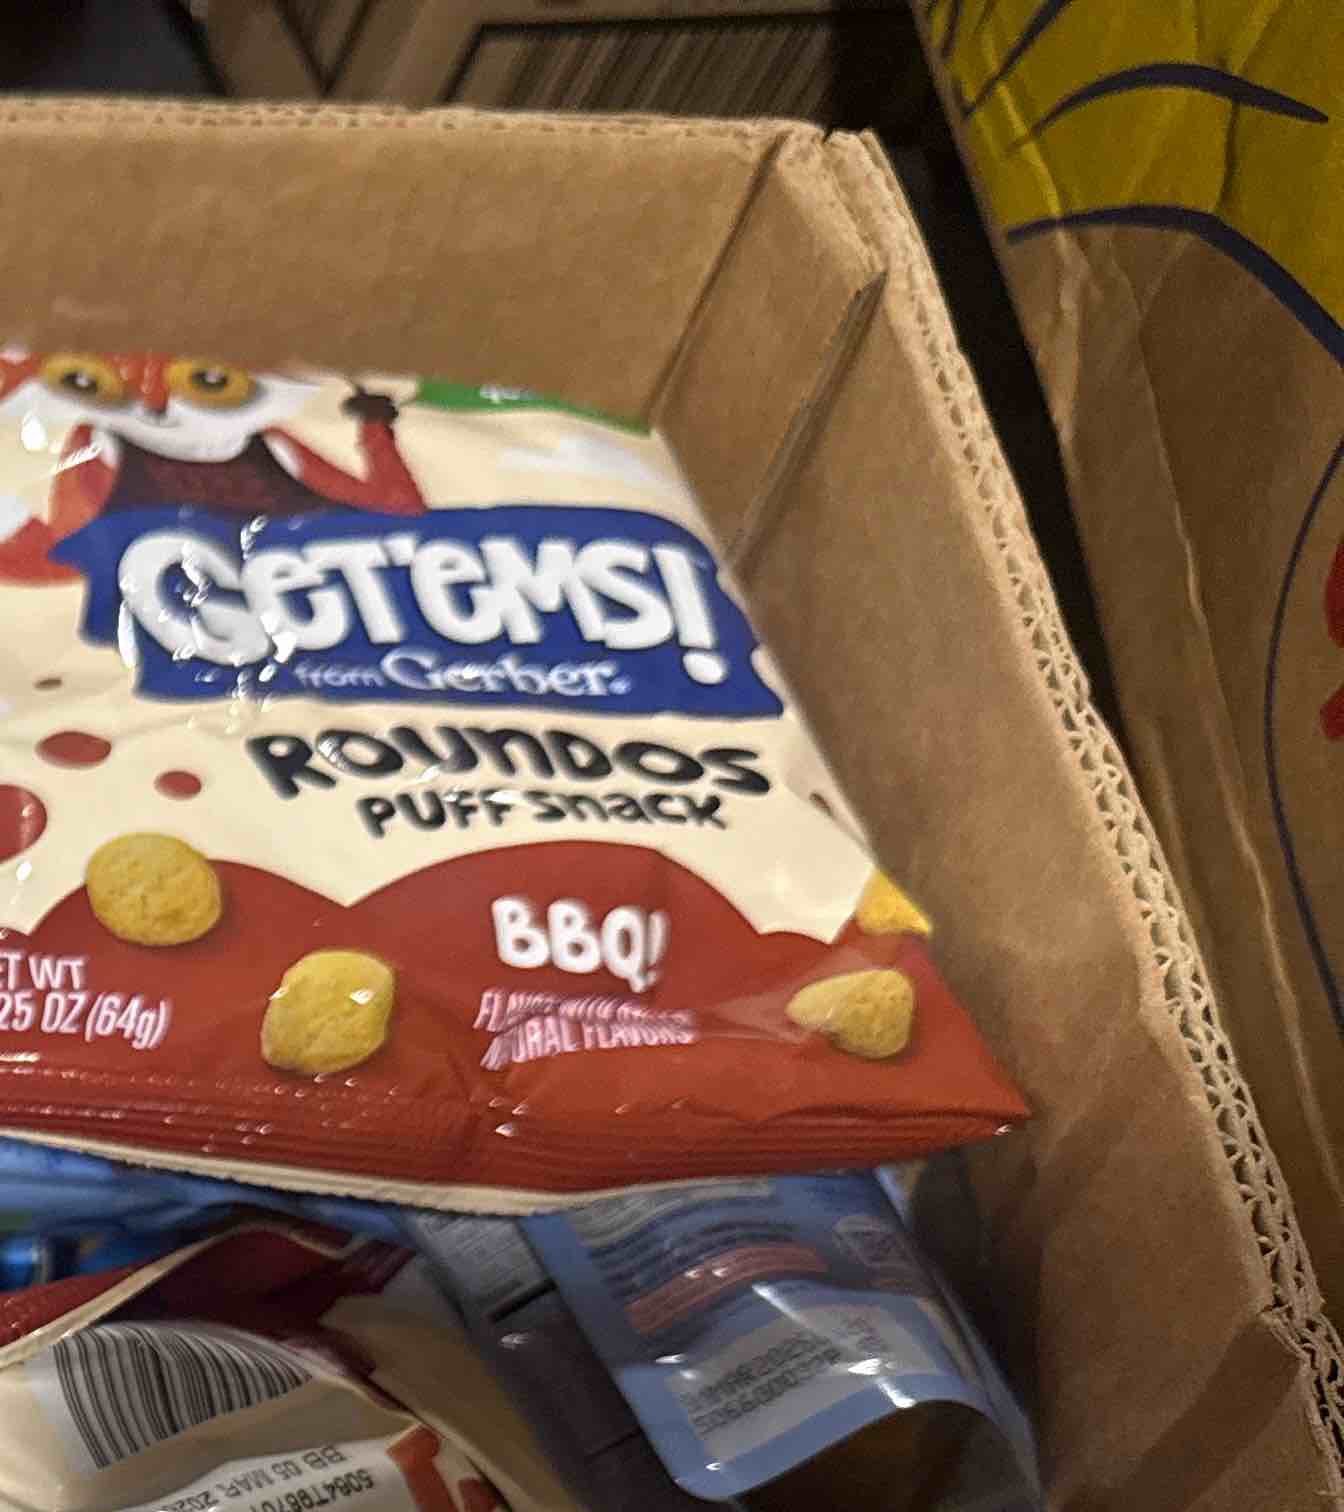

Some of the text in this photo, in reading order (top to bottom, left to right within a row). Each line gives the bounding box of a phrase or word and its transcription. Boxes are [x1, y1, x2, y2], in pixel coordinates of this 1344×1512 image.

[28, 955, 86, 990] WT
[492, 895, 669, 992] BBQ!
[39, 993, 85, 1036] OZ
[85, 993, 172, 1052] (64g)
